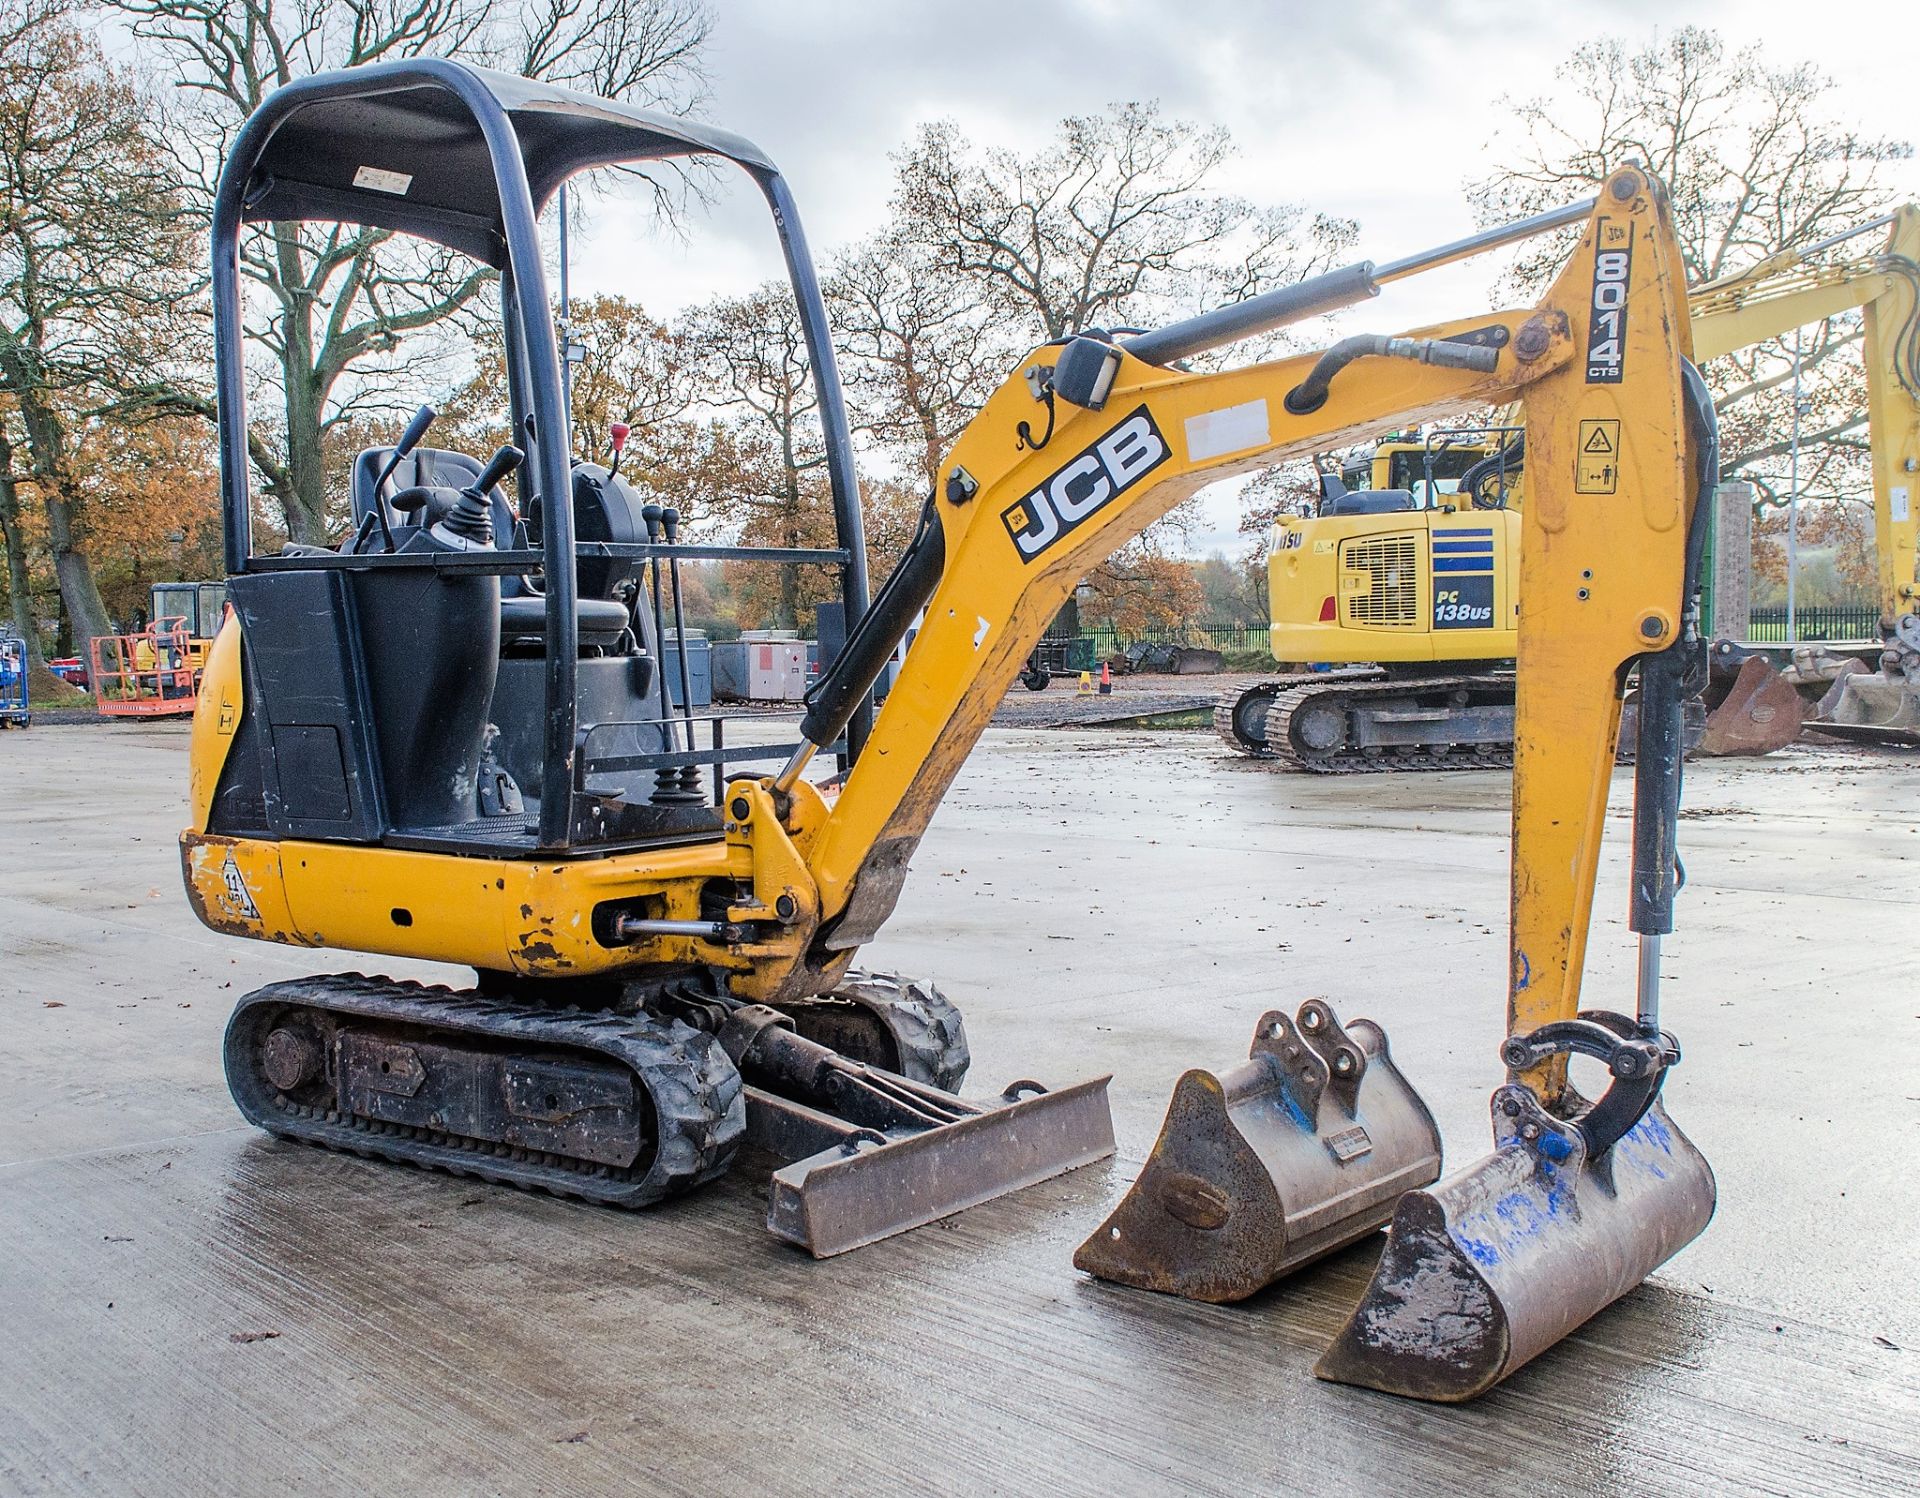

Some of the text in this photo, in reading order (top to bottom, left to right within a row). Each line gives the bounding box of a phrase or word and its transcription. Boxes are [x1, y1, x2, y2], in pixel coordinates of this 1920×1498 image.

[1607, 226, 1626, 242] JCB
[1588, 252, 1629, 367] 8014
[1588, 367, 1620, 377] CTS
[1016, 416, 1163, 554] JCB
[1436, 590, 1459, 604] PC
